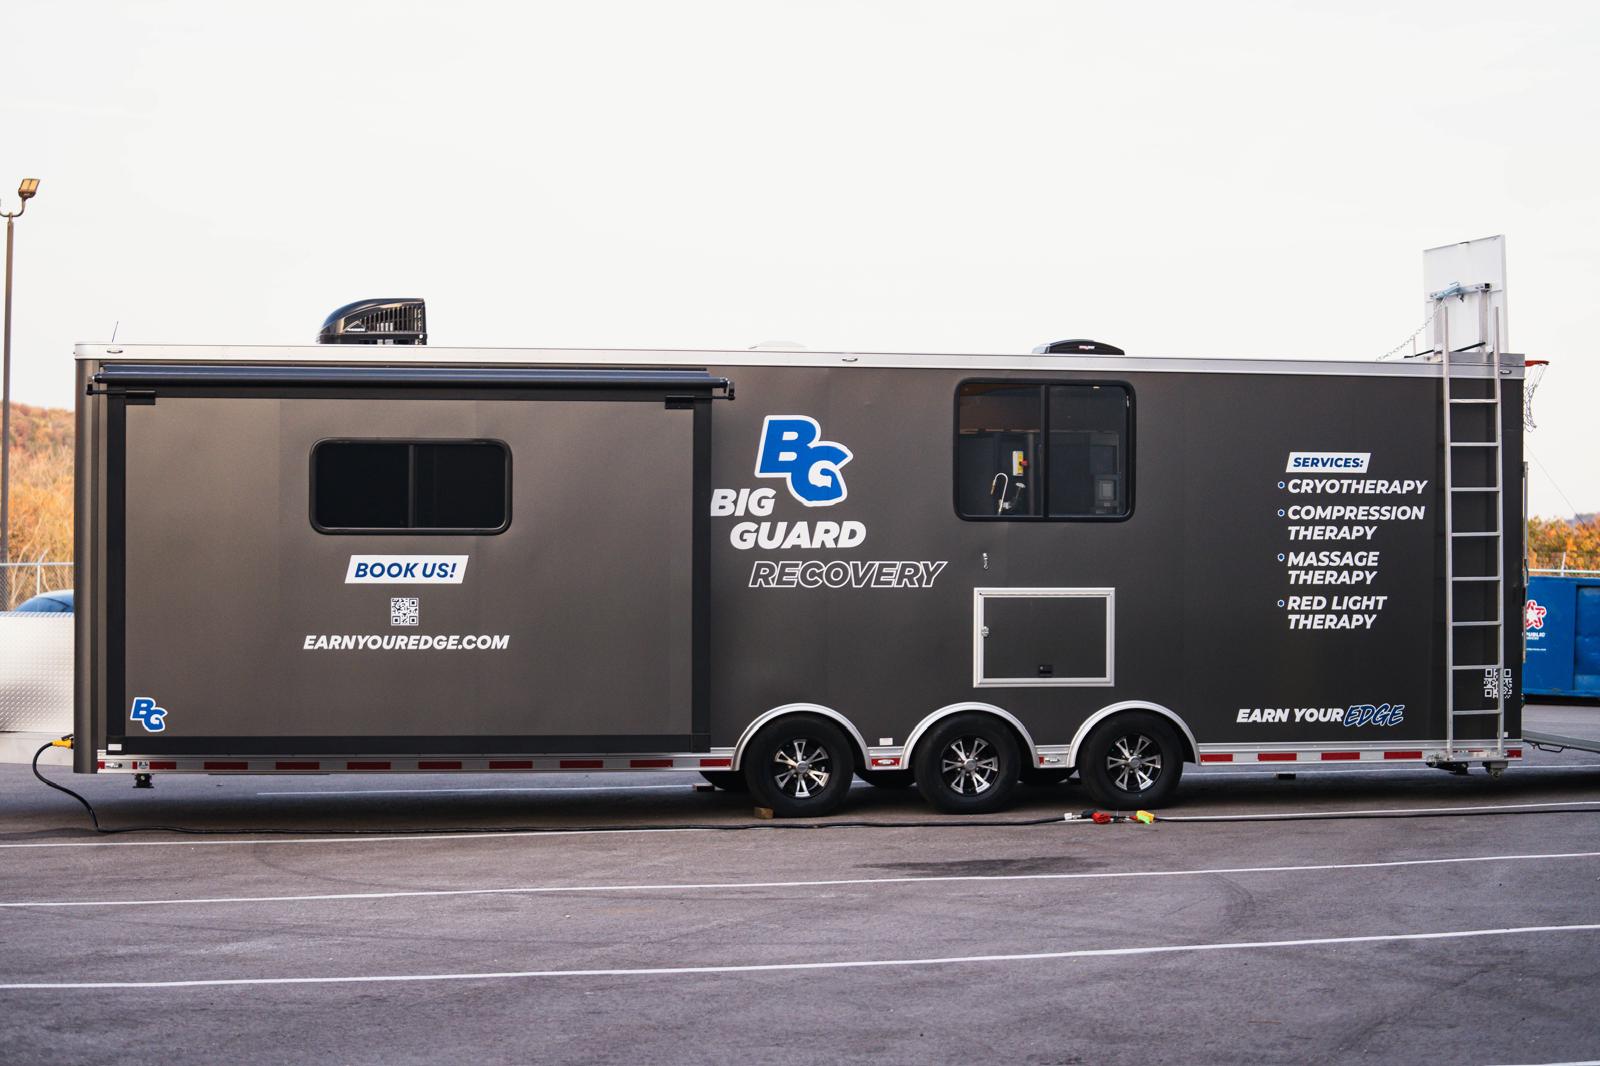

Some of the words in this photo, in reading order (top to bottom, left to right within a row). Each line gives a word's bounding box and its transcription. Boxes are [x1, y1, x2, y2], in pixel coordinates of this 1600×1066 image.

[754, 415, 853, 507] BG
[1293, 457, 1364, 468] SERVICES:
[1287, 479, 1428, 494] CRYOTHERAPY
[710, 488, 776, 517] BIG
[1287, 505, 1425, 520] COMPRESSION
[730, 521, 867, 550] GUARD
[1288, 526, 1377, 540] THERAPY
[1287, 551, 1380, 567] MASSAGE
[355, 562, 418, 578] BOOK
[422, 562, 457, 578] US!
[748, 560, 948, 588] RECOVERY
[1288, 570, 1378, 585] THERAPY
[1287, 596, 1327, 610] RED
[1331, 596, 1388, 610] LIGHT
[1288, 614, 1377, 629] THERAPY
[303, 635, 510, 650] EARNYOUREDGE.COM
[130, 697, 168, 732] BG
[1236, 708, 1290, 723] EARN
[1293, 708, 1344, 723] YOUR
[1343, 702, 1406, 728] EDGE
